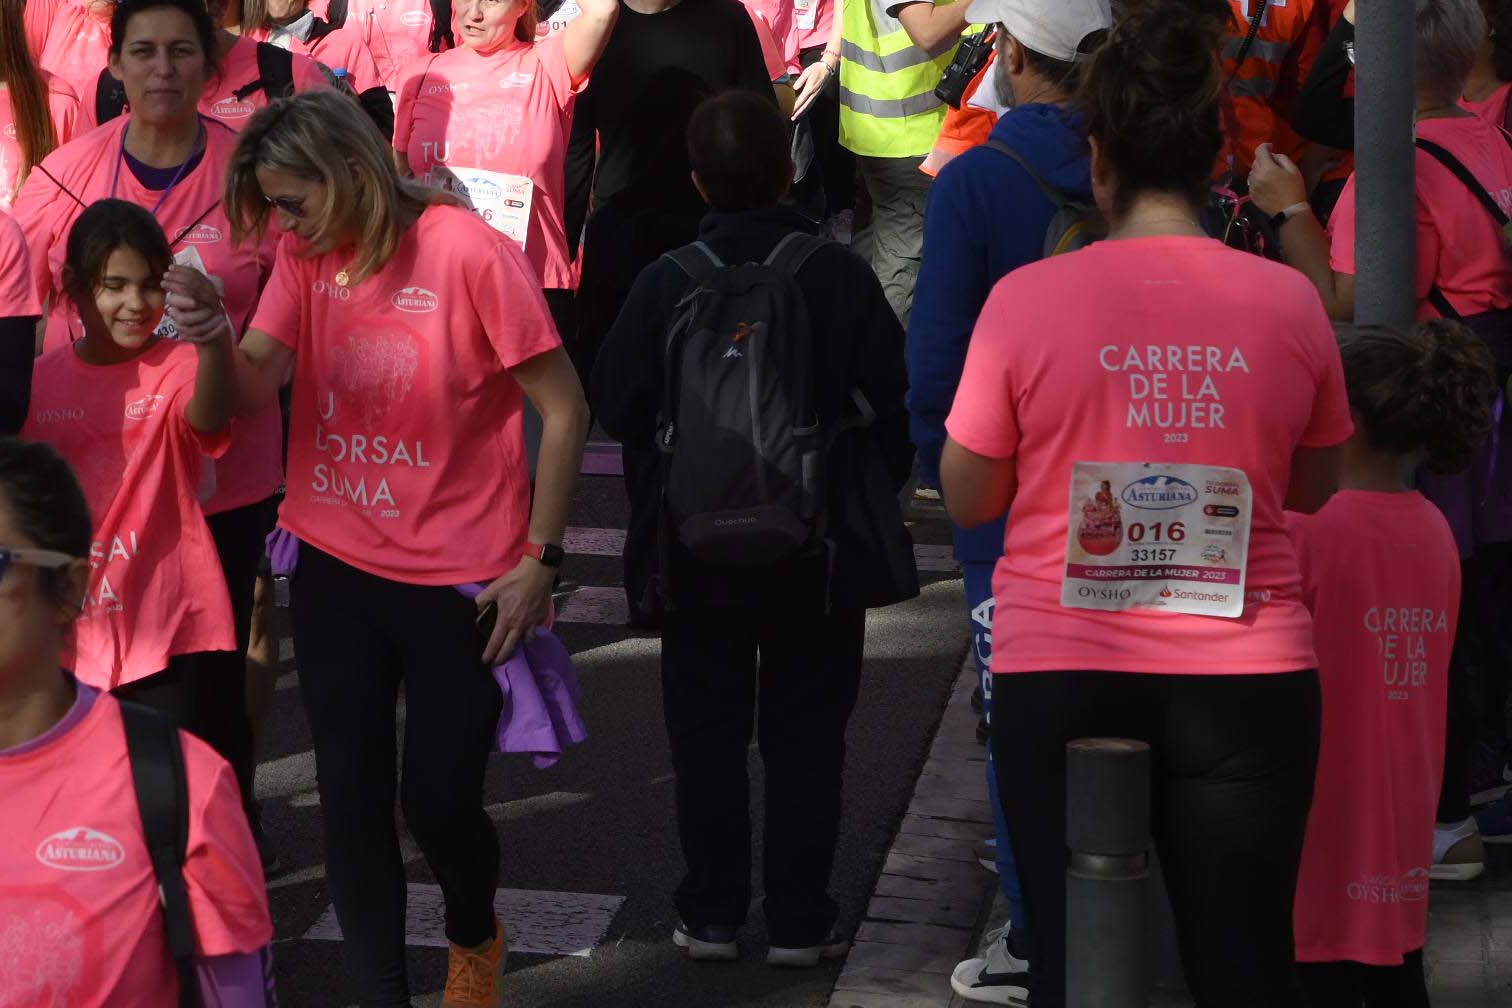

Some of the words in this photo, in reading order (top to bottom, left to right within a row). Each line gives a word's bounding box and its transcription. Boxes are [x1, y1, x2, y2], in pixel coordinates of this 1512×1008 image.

[552, 21, 568, 31] 01
[422, 142, 450, 163] TU
[1099, 345, 1250, 374] CARRERA
[1129, 373, 1168, 400] DE
[1182, 373, 1220, 400] LA
[1126, 402, 1225, 429] MUJER
[1164, 433, 1188, 443] 2023
[312, 463, 395, 506] SUMA
[1127, 486, 1192, 502] ASTURIANA
[1204, 486, 1239, 496] SUMA
[1127, 521, 1186, 542] 016
[1131, 548, 1177, 562] 33157
[1085, 569, 1131, 578] CARRERA
[1134, 568, 1148, 577] DE
[1150, 569, 1163, 577] LA
[1165, 568, 1199, 578] MUJER
[1202, 570, 1227, 580] 2023
[1078, 586, 1131, 600] OYSHO
[1173, 588, 1229, 603] Santander
[1406, 636, 1427, 659] LA
[1384, 661, 1428, 686] UJER
[46, 844, 118, 862] ASTURIANA
